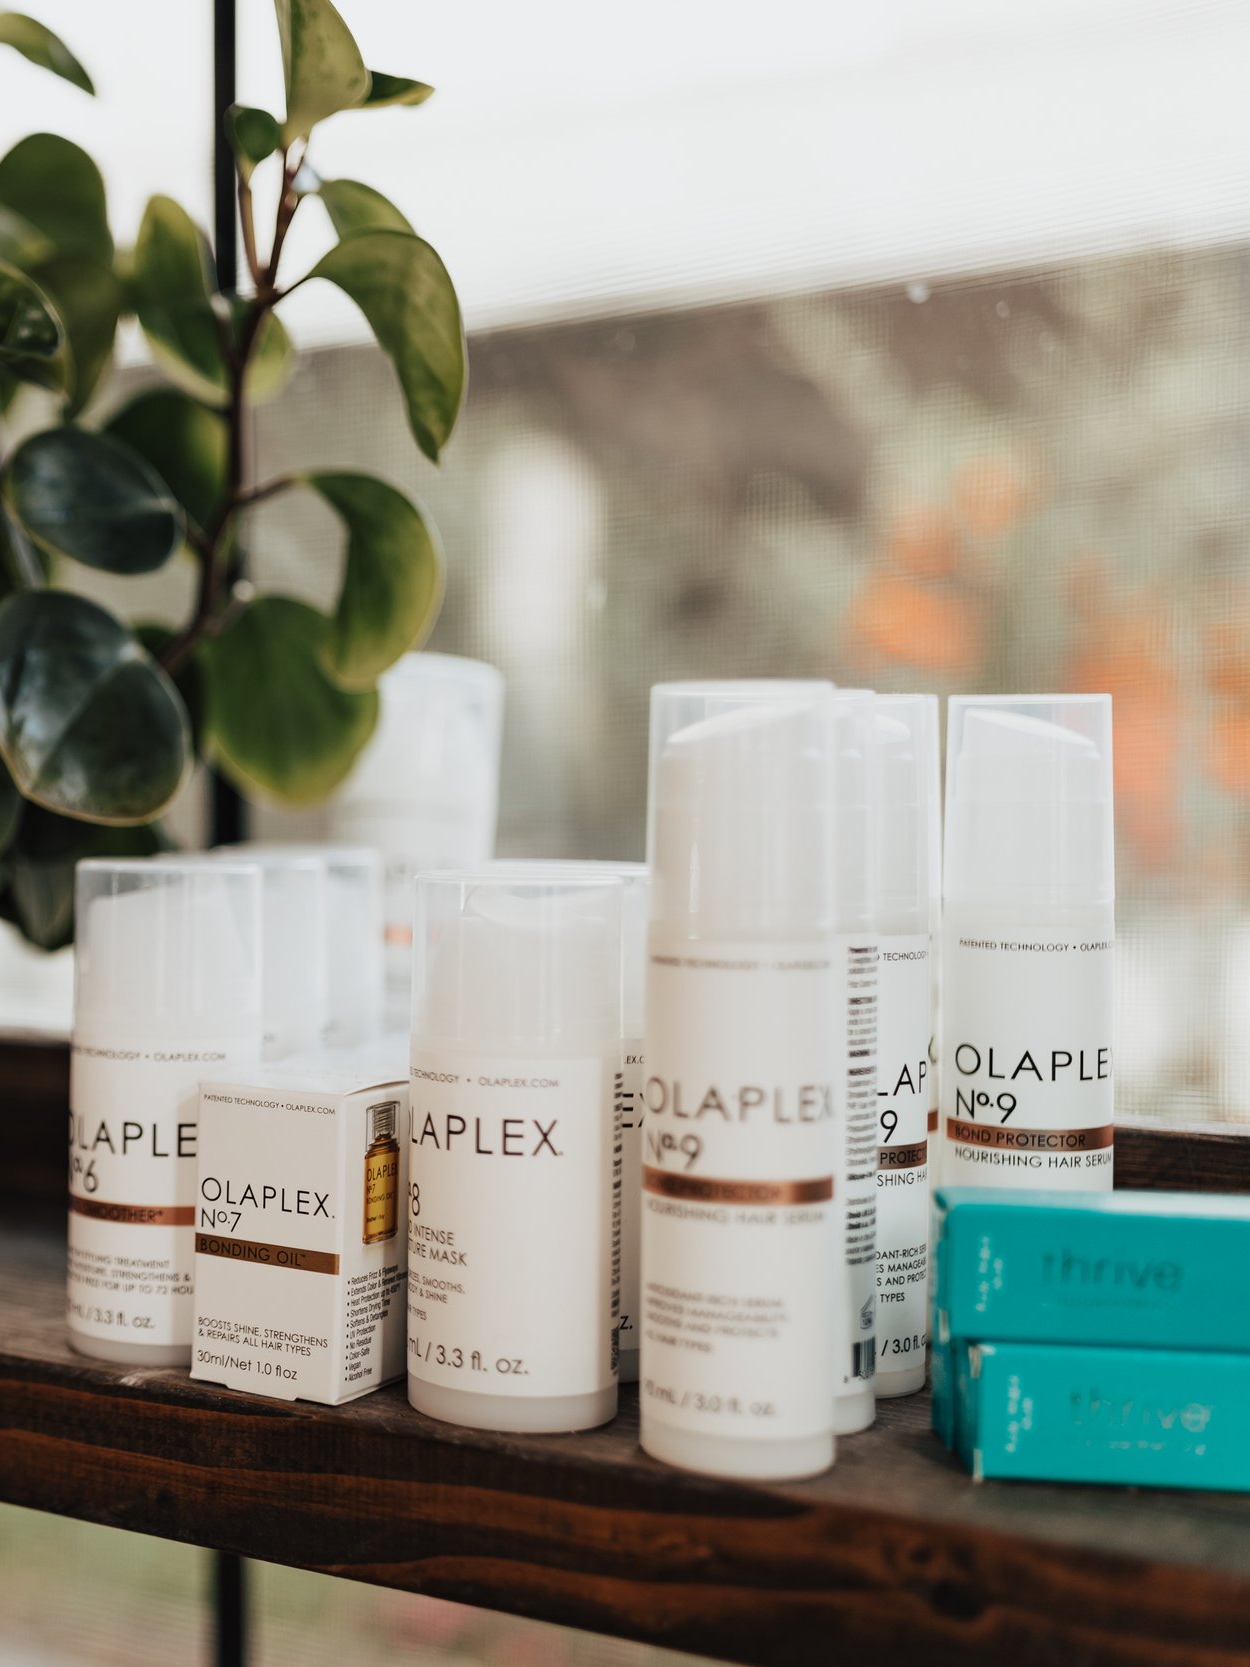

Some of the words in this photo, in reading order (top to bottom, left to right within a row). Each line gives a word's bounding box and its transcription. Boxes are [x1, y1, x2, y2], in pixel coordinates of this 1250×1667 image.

[959, 938, 997, 950] PATENTED
[1000, 941, 1069, 953] TECHNOLOGY
[955, 1043, 1114, 1082] OLAPLE
[478, 1075, 560, 1088] OLAPLEX.COM
[203, 1093, 233, 1105] PATENTED
[234, 1096, 280, 1110] TECHNOLOGY
[285, 1102, 337, 1116] OLAPLEX.COM
[645, 1075, 835, 1126] OLAPLEX
[68, 1111, 197, 1158] LAPLE
[955, 1125, 991, 1144] BOND
[996, 1131, 1087, 1149] PROTECTOR
[955, 1146, 1043, 1169] NOURISHING
[1048, 1156, 1082, 1169] HAIR
[1085, 1151, 1112, 1168] SERUM
[366, 1161, 398, 1182] OLAPLE
[877, 1171, 915, 1188] SHING
[916, 1167, 927, 1184] HA
[413, 1223, 455, 1247] INTENSE
[200, 1237, 270, 1262] BONDING
[429, 1247, 469, 1268] MASK
[170, 1285, 195, 1297] HOU
[885, 1275, 906, 1287] AND
[425, 1289, 449, 1304] SHINE
[880, 1291, 906, 1303] TYPES
[198, 1316, 231, 1332] BOOSTS
[234, 1322, 262, 1338] SHINE,
[264, 1328, 328, 1349] STRENGTHENS
[198, 1327, 204, 1338] &
[207, 1330, 240, 1345] REPAIRS
[243, 1336, 258, 1348] ALL
[261, 1340, 282, 1352] HAIR
[285, 1343, 311, 1357] TYPES
[892, 1336, 911, 1354] 3.0
[197, 1348, 252, 1373] 30ml/Net
[256, 1360, 272, 1377] 1.0
[435, 1344, 464, 1369] 3.3
[470, 1349, 488, 1373] fl.
[495, 1357, 529, 1376] oz.
